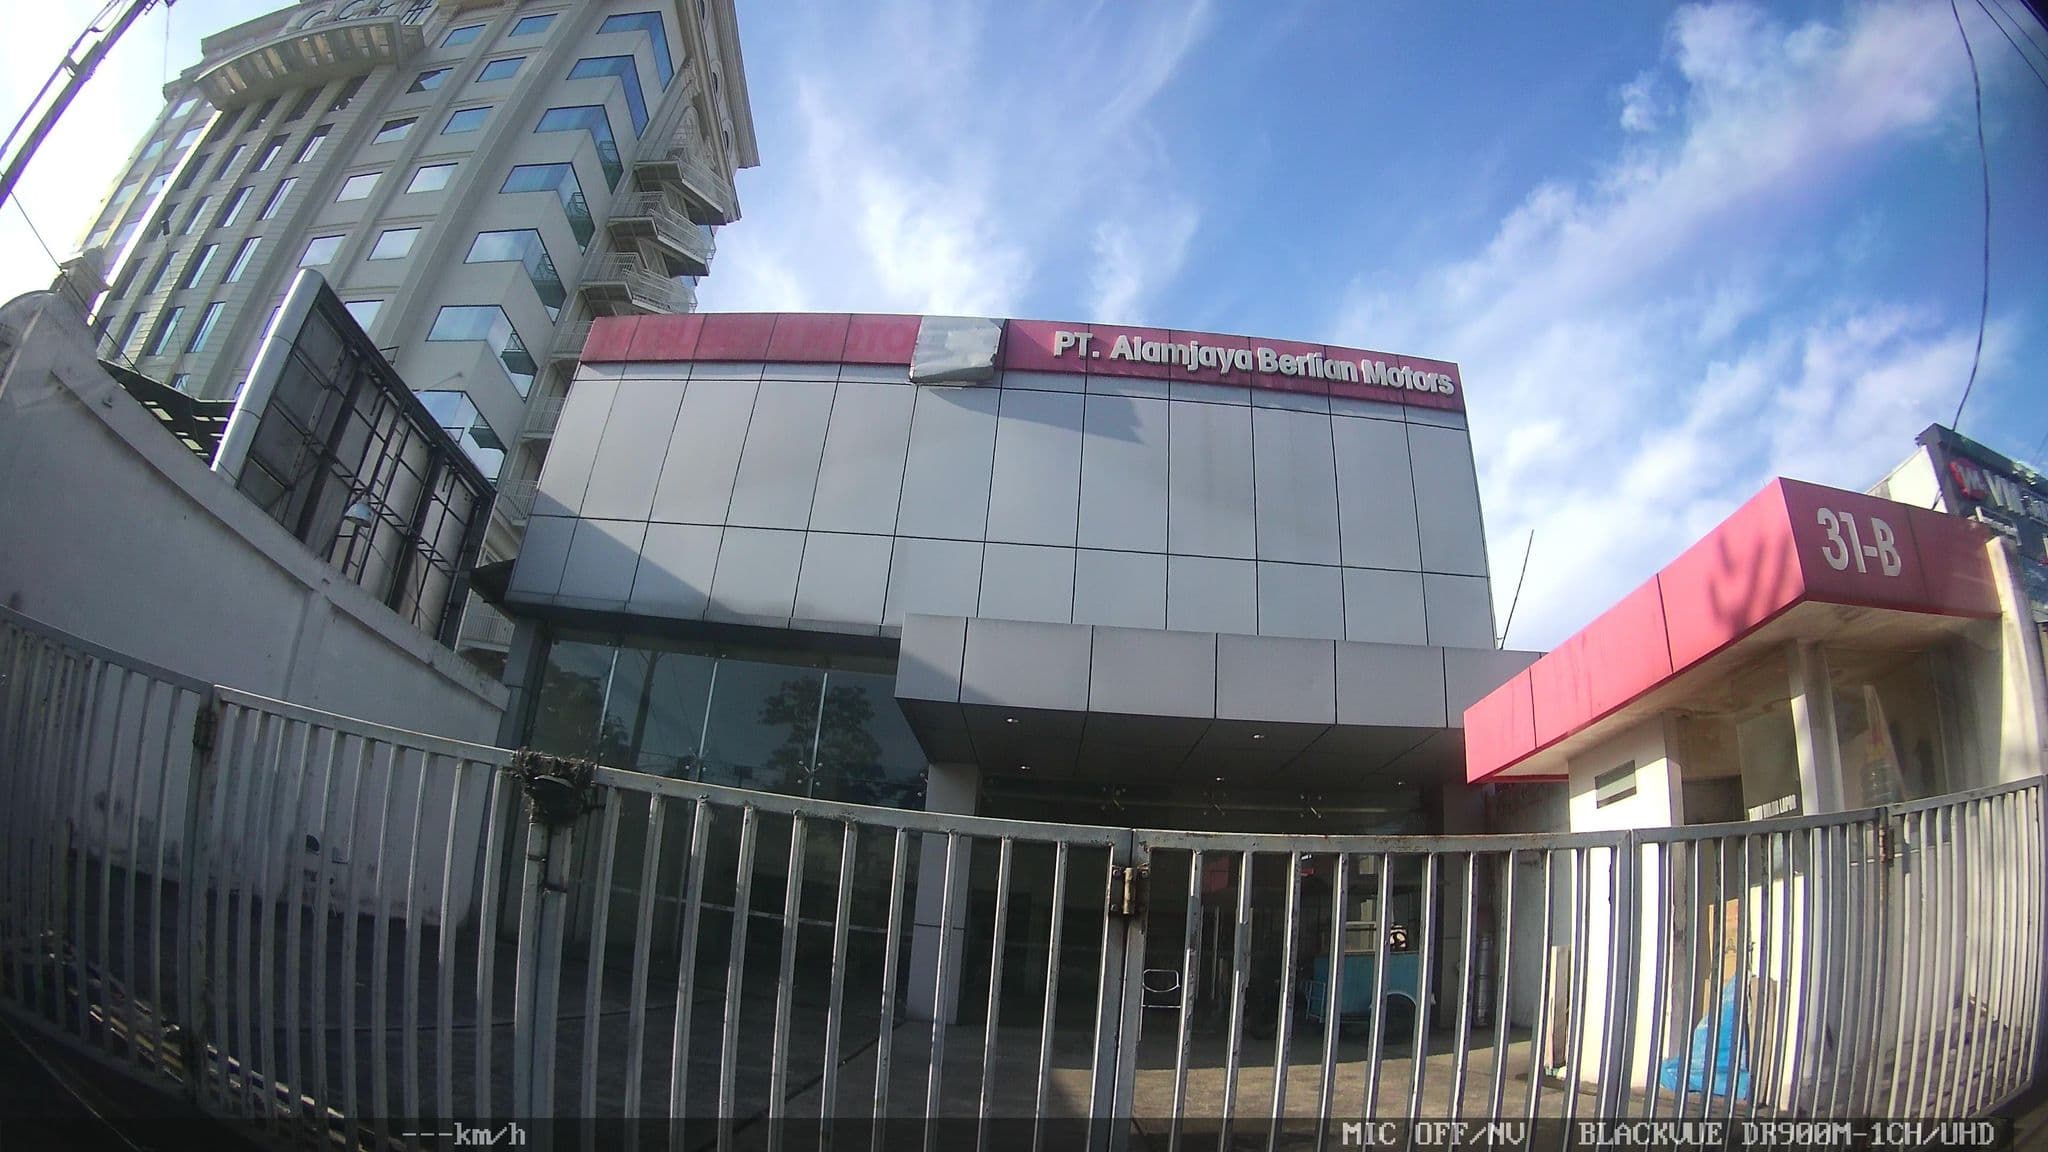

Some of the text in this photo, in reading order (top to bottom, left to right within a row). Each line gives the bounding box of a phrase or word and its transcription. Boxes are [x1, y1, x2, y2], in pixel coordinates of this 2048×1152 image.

[1053, 330, 1456, 396] PT. Alamjaya Berlian Motors
[1817, 506, 1903, 577] 31-B
